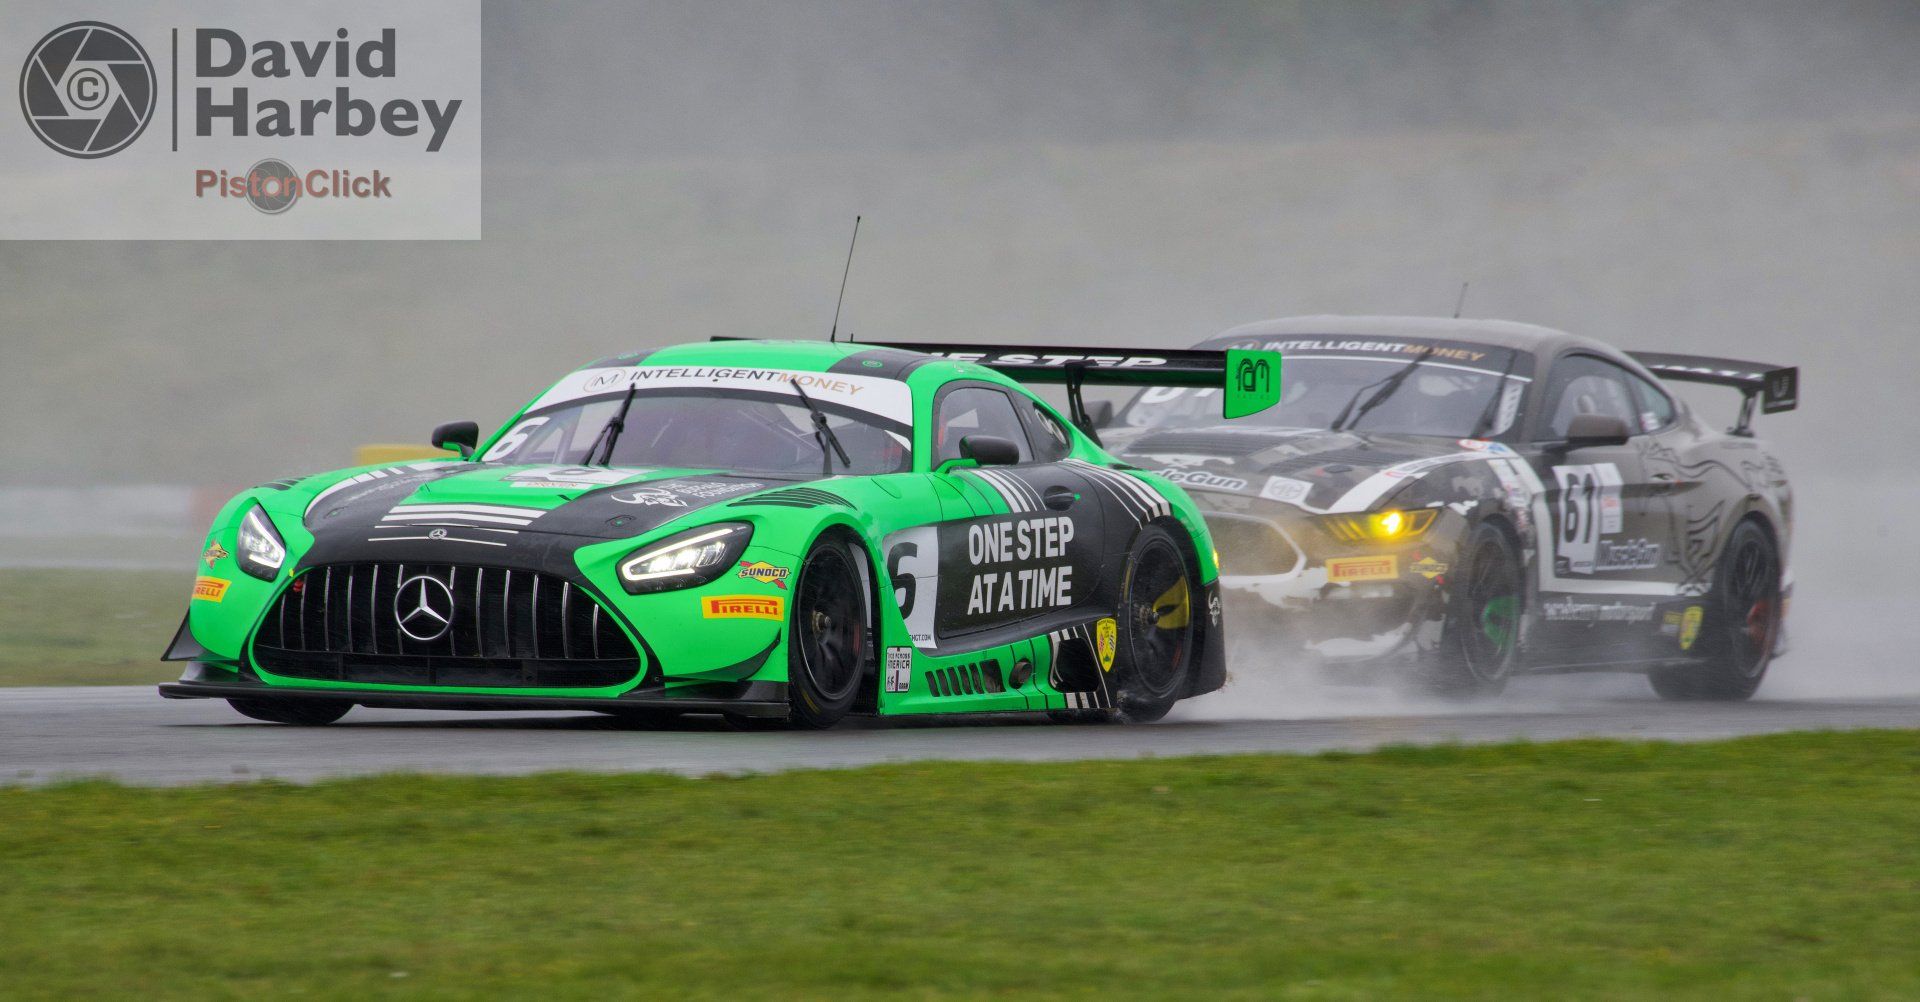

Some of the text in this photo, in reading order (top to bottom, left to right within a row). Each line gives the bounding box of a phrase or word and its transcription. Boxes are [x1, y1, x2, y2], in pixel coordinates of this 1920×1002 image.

[481, 416, 551, 462] 6
[1565, 473, 1595, 544] 61
[968, 516, 1075, 566] ONE STEP
[740, 568, 788, 578] SUNOCO
[887, 542, 918, 620] 6
[967, 566, 1073, 615] AT A TIME
[1332, 560, 1391, 577] PIRELLI
[710, 598, 778, 616] PIRELLI
